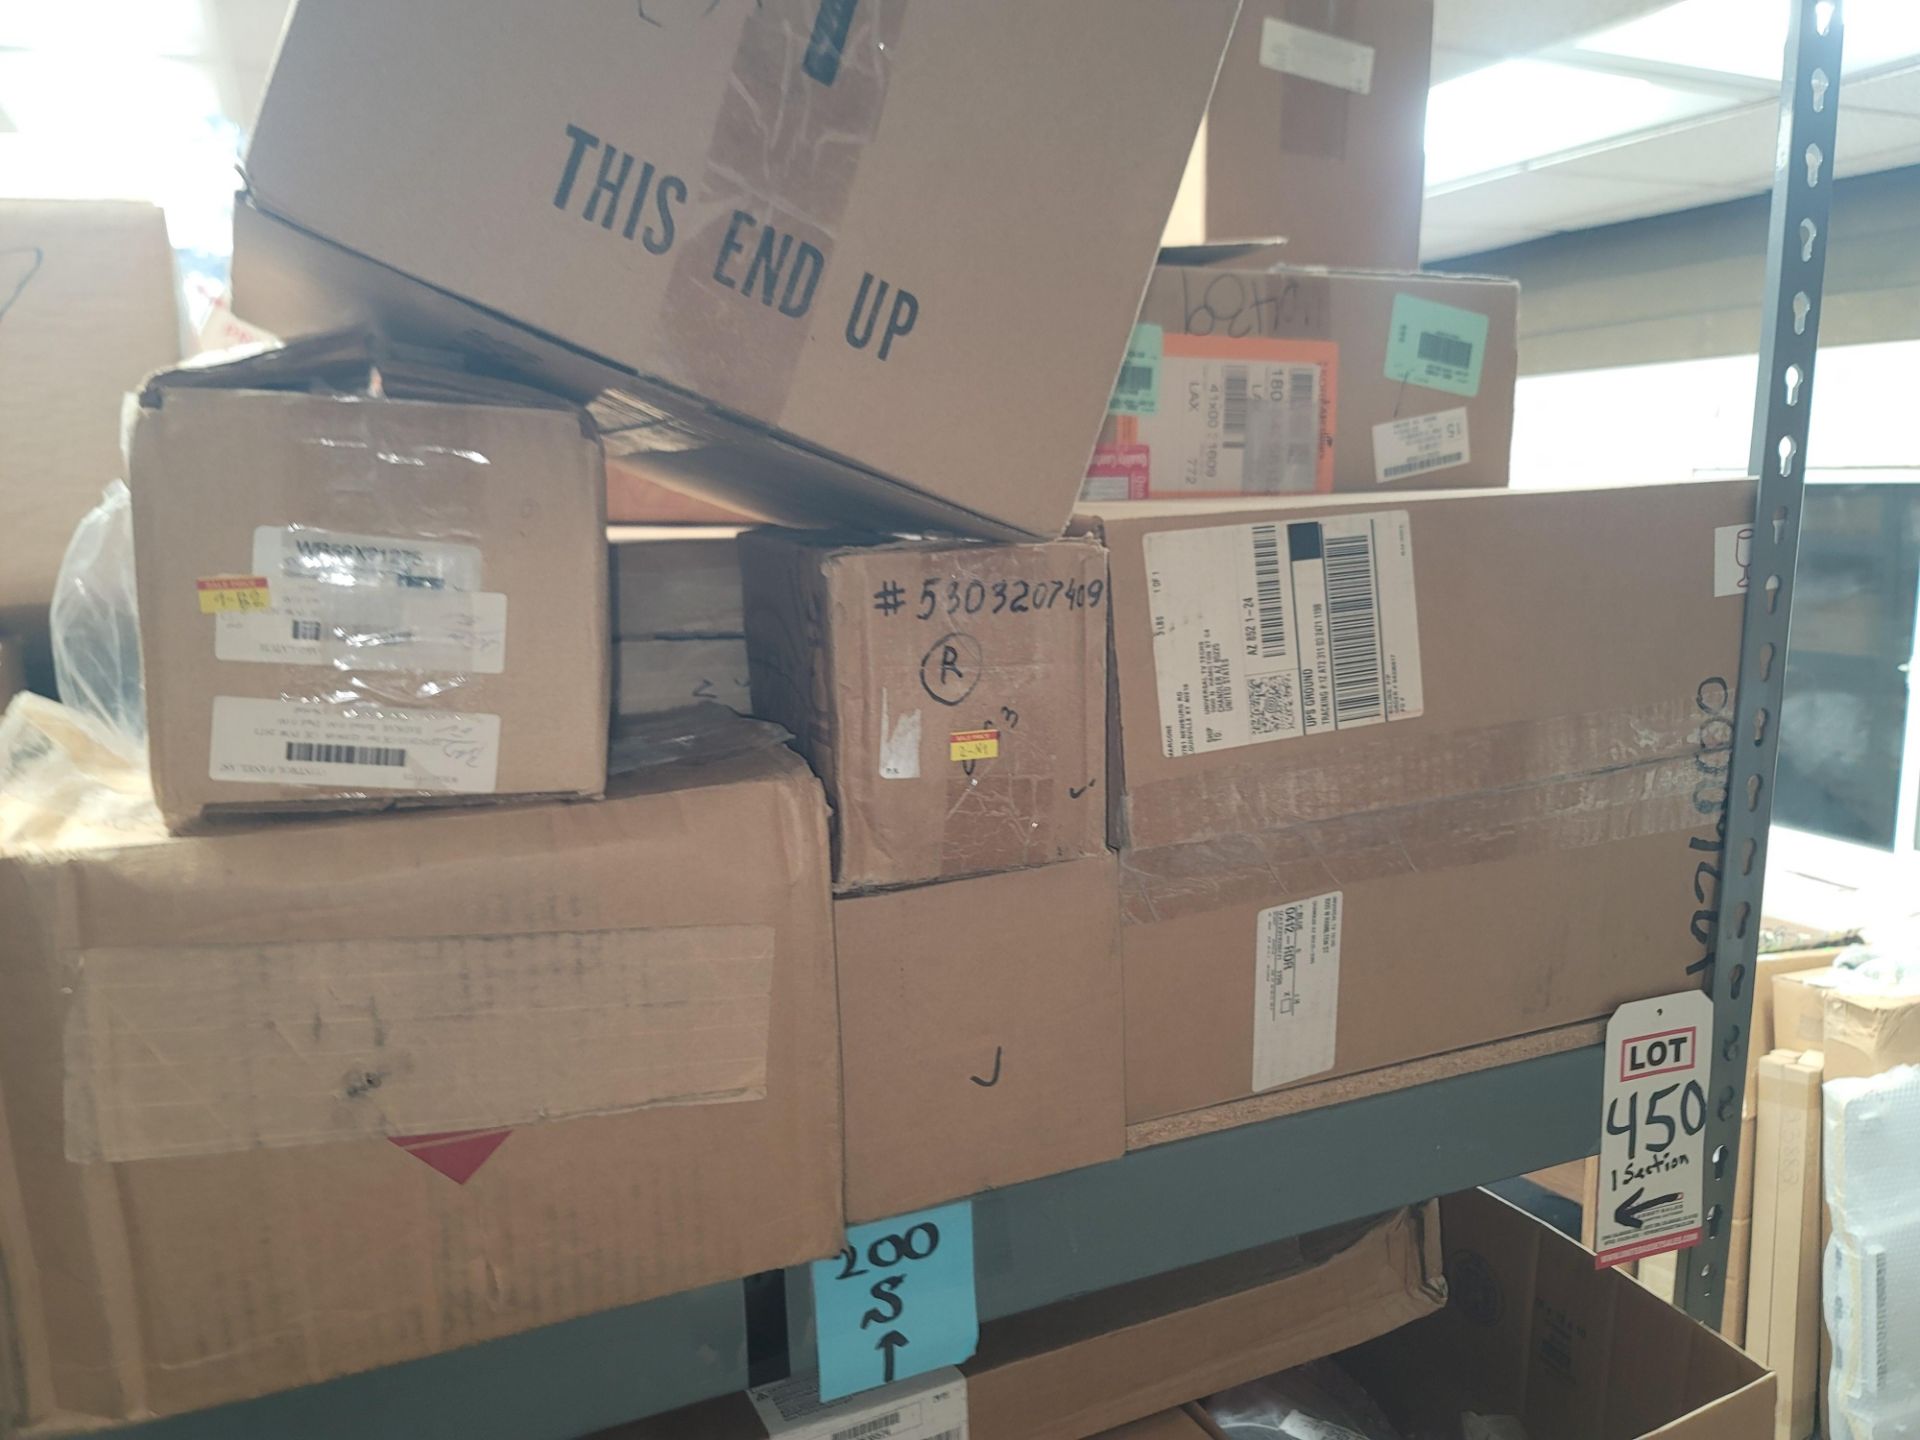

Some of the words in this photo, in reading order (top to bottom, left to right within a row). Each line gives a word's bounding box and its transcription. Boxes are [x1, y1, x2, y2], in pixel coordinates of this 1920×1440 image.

[553, 123, 688, 256] THIS
[713, 209, 824, 319] END
[844, 271, 920, 362] UP
[1189, 382, 1199, 412] LAX
[1154, 615, 1165, 630] LBS
[1243, 625, 1257, 642] 852
[941, 645, 965, 685] R
[1245, 643, 1258, 656] AZ
[1220, 657, 1230, 684] STATES
[1301, 667, 1315, 706] GROUND
[1201, 677, 1210, 714] UNIVERSAL
[1214, 675, 1225, 712] CHANDLER
[1222, 685, 1233, 711] UNITED
[1318, 690, 1331, 725] TRACKING
[1304, 708, 1317, 727] UPS
[1630, 1037, 1688, 1071] LOT
[1606, 1079, 1707, 1160] 450
[1622, 1152, 1690, 1186] Section
[833, 1221, 940, 1280] 200
[860, 1274, 907, 1330] S
